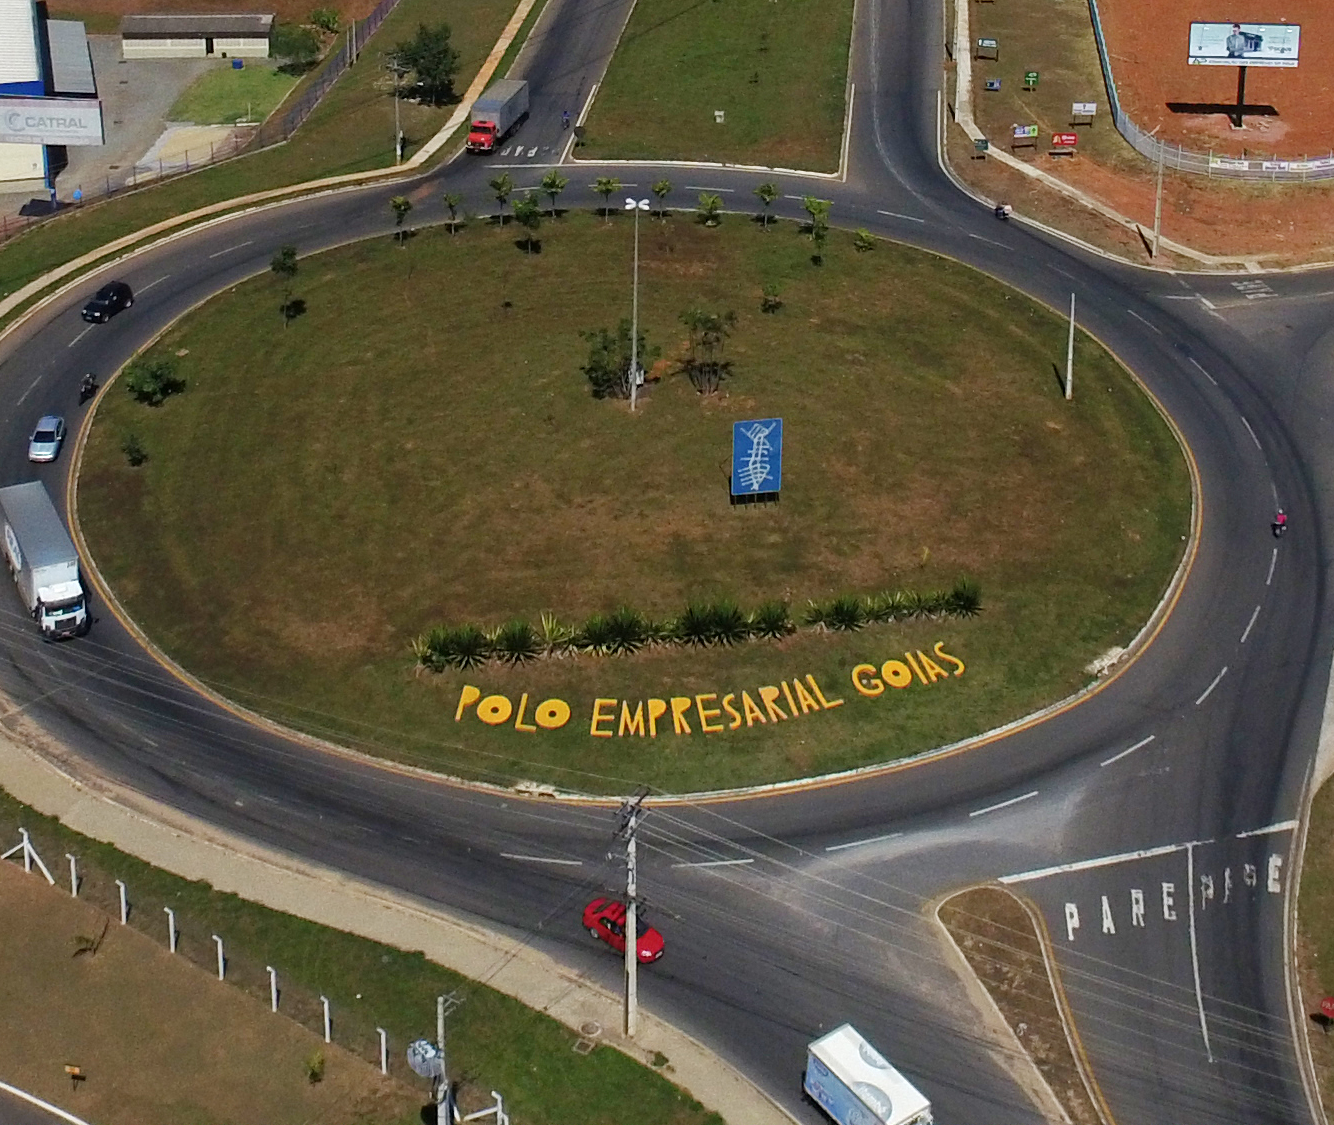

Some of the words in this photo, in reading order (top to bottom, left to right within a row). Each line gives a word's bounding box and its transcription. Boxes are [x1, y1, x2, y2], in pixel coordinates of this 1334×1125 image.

[24, 116, 88, 129] CATRAL
[455, 684, 571, 732] POLO
[590, 673, 844, 738] EMPRESARIAL
[851, 640, 966, 698] GOIAS
[1065, 881, 1177, 942] PARE
